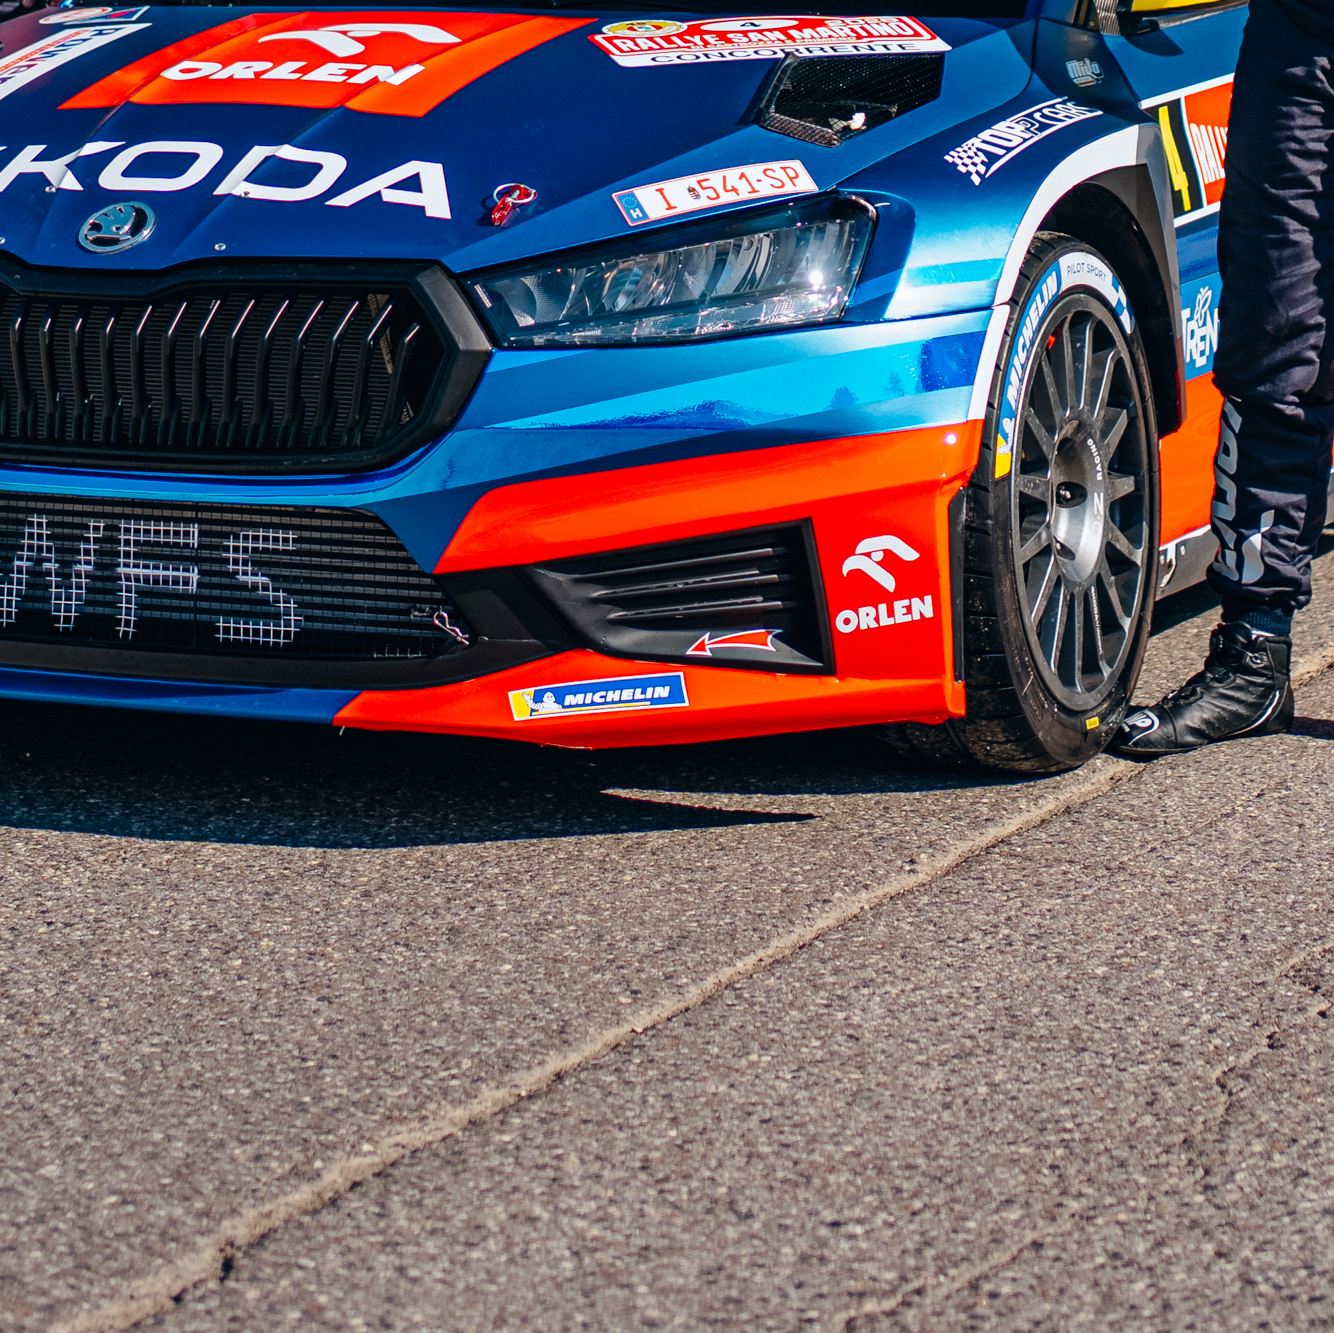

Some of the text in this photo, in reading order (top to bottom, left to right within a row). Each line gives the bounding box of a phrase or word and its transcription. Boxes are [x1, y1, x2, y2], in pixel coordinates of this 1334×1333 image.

[612, 21, 915, 52] RALLYE SAN MARTINO
[650, 43, 920, 63] CONCORRENTE
[159, 61, 426, 86] ORLEN
[1158, 106, 1191, 211] 4
[1007, 262, 1107, 405] MICHELIN PILOT SPORT
[1086, 438, 1103, 481] RACING
[835, 595, 934, 634] ORLEN
[564, 686, 670, 705] MICHELIN
